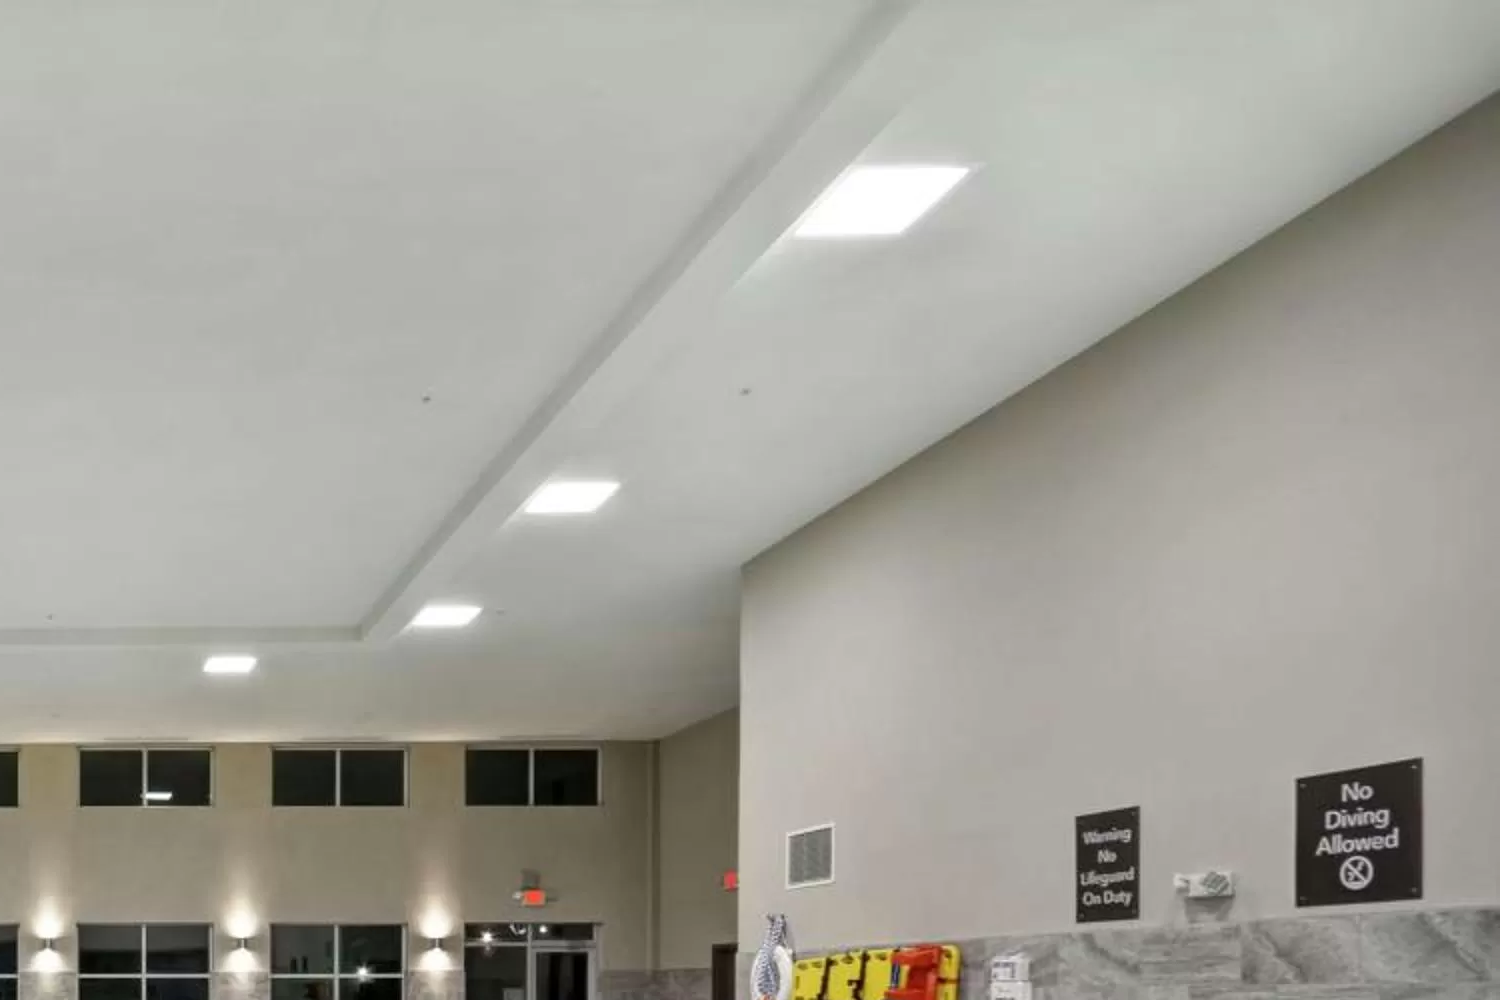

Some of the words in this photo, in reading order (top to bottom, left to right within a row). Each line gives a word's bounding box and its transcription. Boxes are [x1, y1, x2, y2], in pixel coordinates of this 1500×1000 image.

[1341, 782, 1374, 803] No
[1324, 807, 1390, 830] Diving
[1083, 827, 1132, 845] Warning
[1315, 826, 1399, 856] Allowed
[1098, 849, 1117, 864] No
[1081, 866, 1135, 887] Lifeguard
[1083, 891, 1102, 906] On
[1103, 889, 1132, 907] Duty
